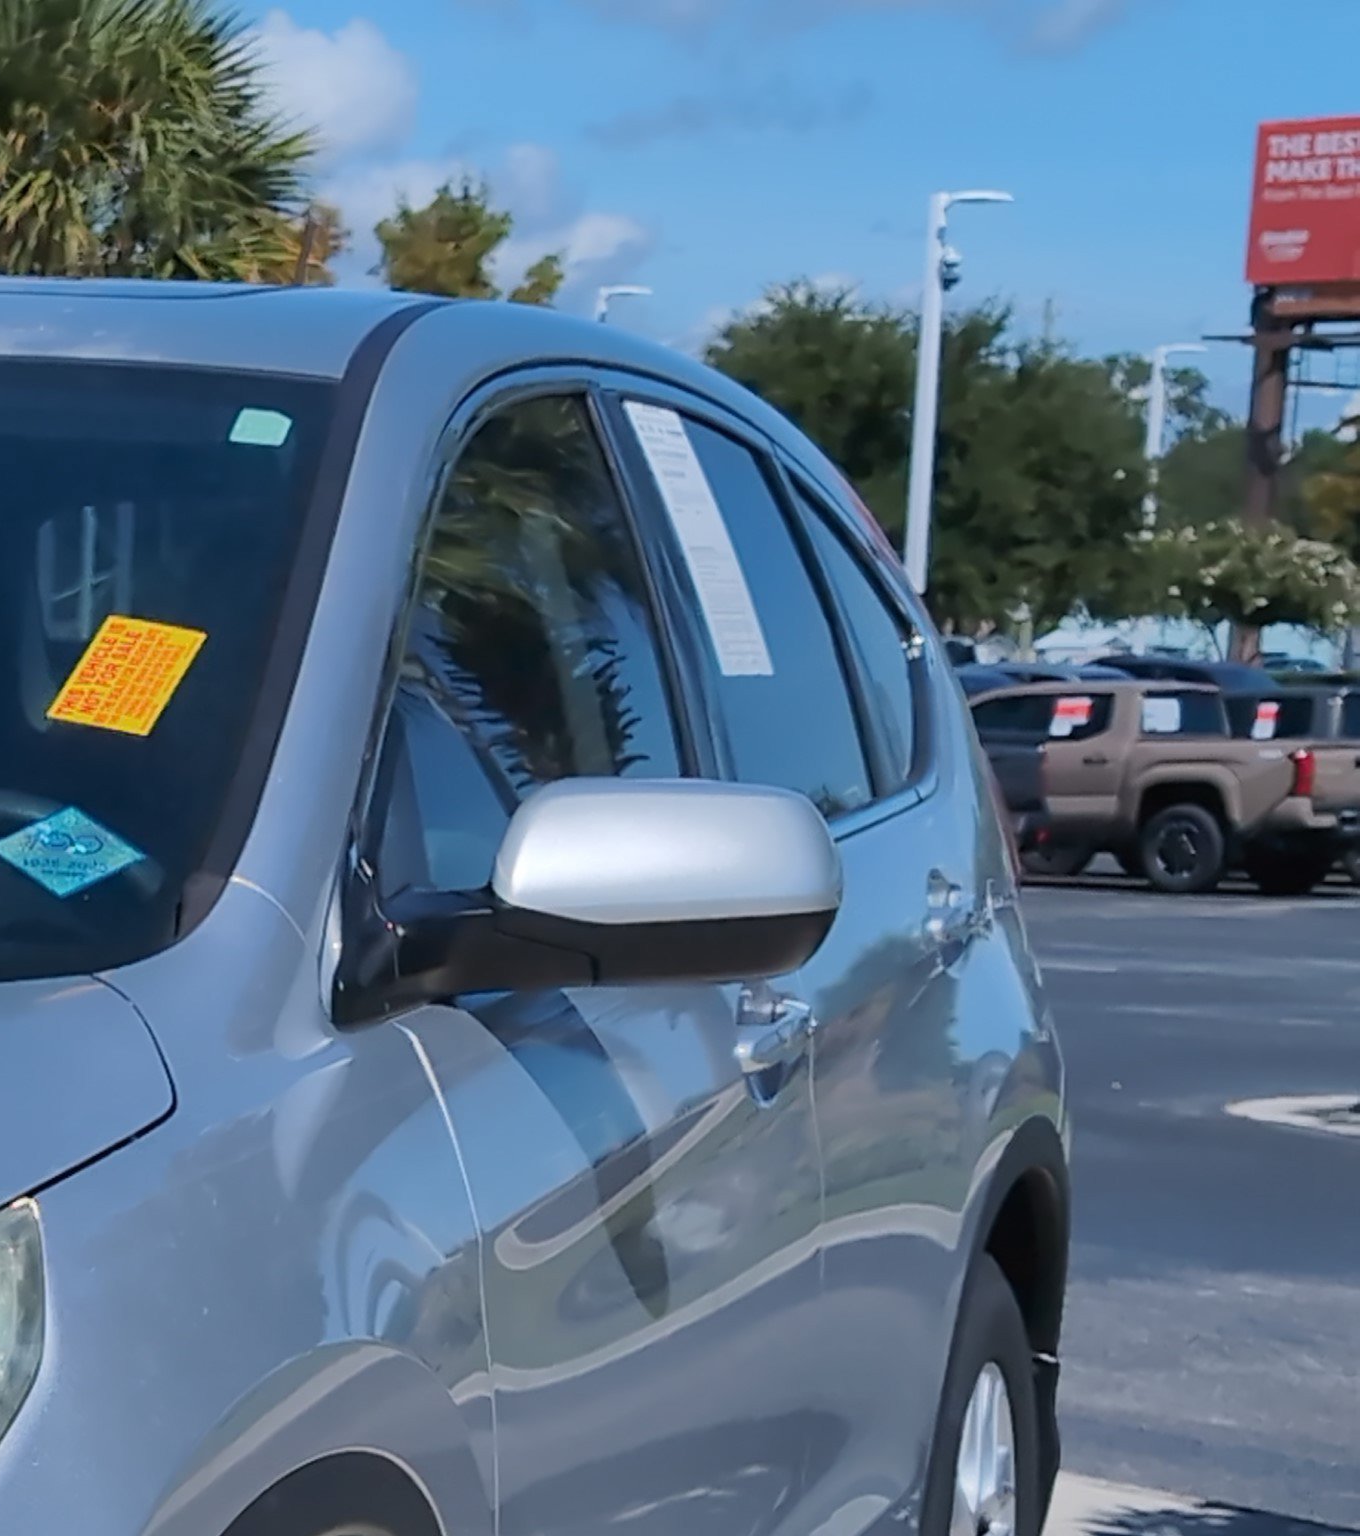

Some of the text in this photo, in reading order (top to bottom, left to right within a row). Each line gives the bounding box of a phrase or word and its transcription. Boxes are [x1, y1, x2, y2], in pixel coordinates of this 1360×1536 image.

[1265, 158, 1332, 182] MAKE
[1267, 133, 1313, 158] THE
[55, 689, 85, 716] THIS
[74, 636, 118, 685] VEHICLE
[81, 630, 142, 714] NOT FOR SALE
